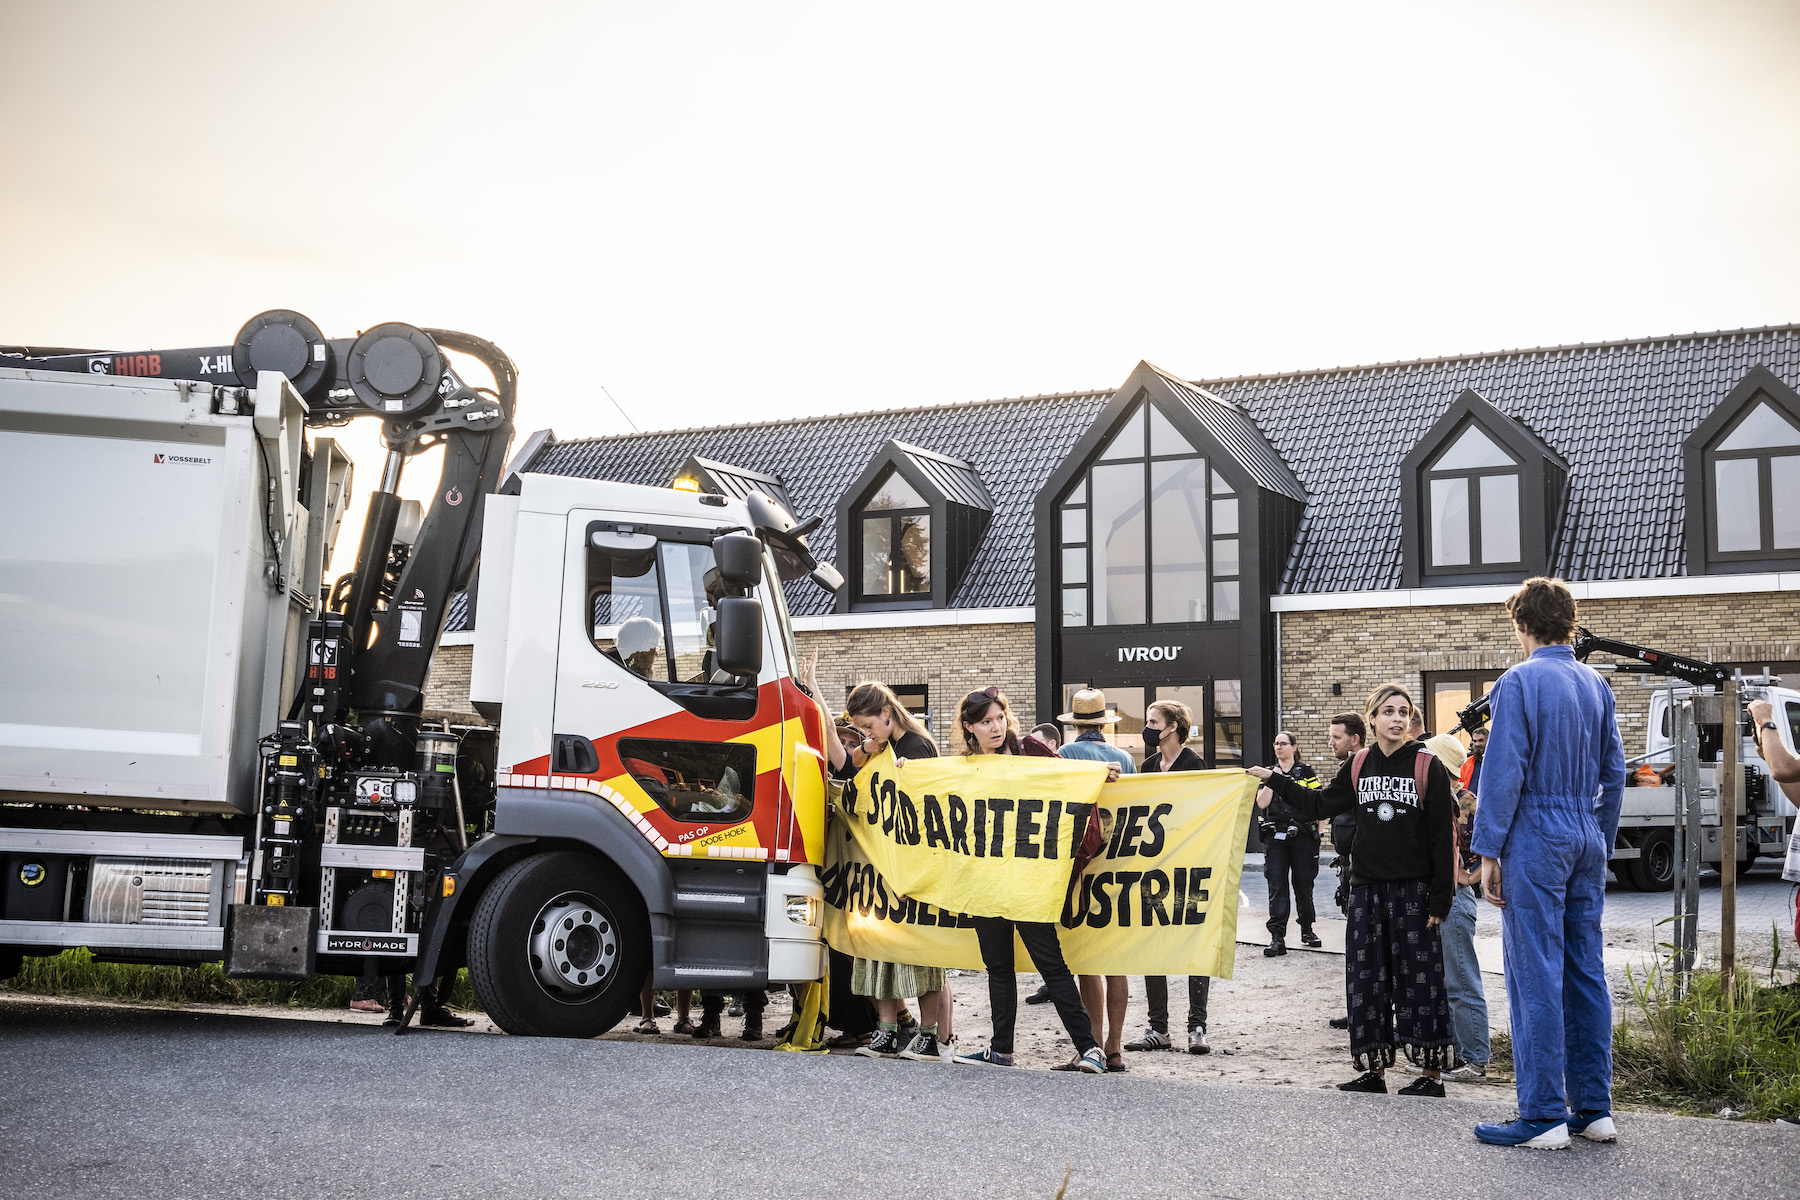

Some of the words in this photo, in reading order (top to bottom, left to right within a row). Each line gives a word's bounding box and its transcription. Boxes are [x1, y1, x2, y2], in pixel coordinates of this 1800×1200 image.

[115, 354, 162, 376] HIAB
[199, 355, 234, 374] X-HI
[168, 455, 212, 464] VOSSEBELT
[309, 666, 336, 679] HAB
[581, 679, 619, 690] 260
[1358, 776, 1417, 794] UTRECHT
[1358, 791, 1419, 808] UNIVERSITY
[678, 830, 696, 842] PAS
[696, 826, 709, 837] OP
[700, 833, 724, 848] DODE
[724, 826, 747, 840] HOEK
